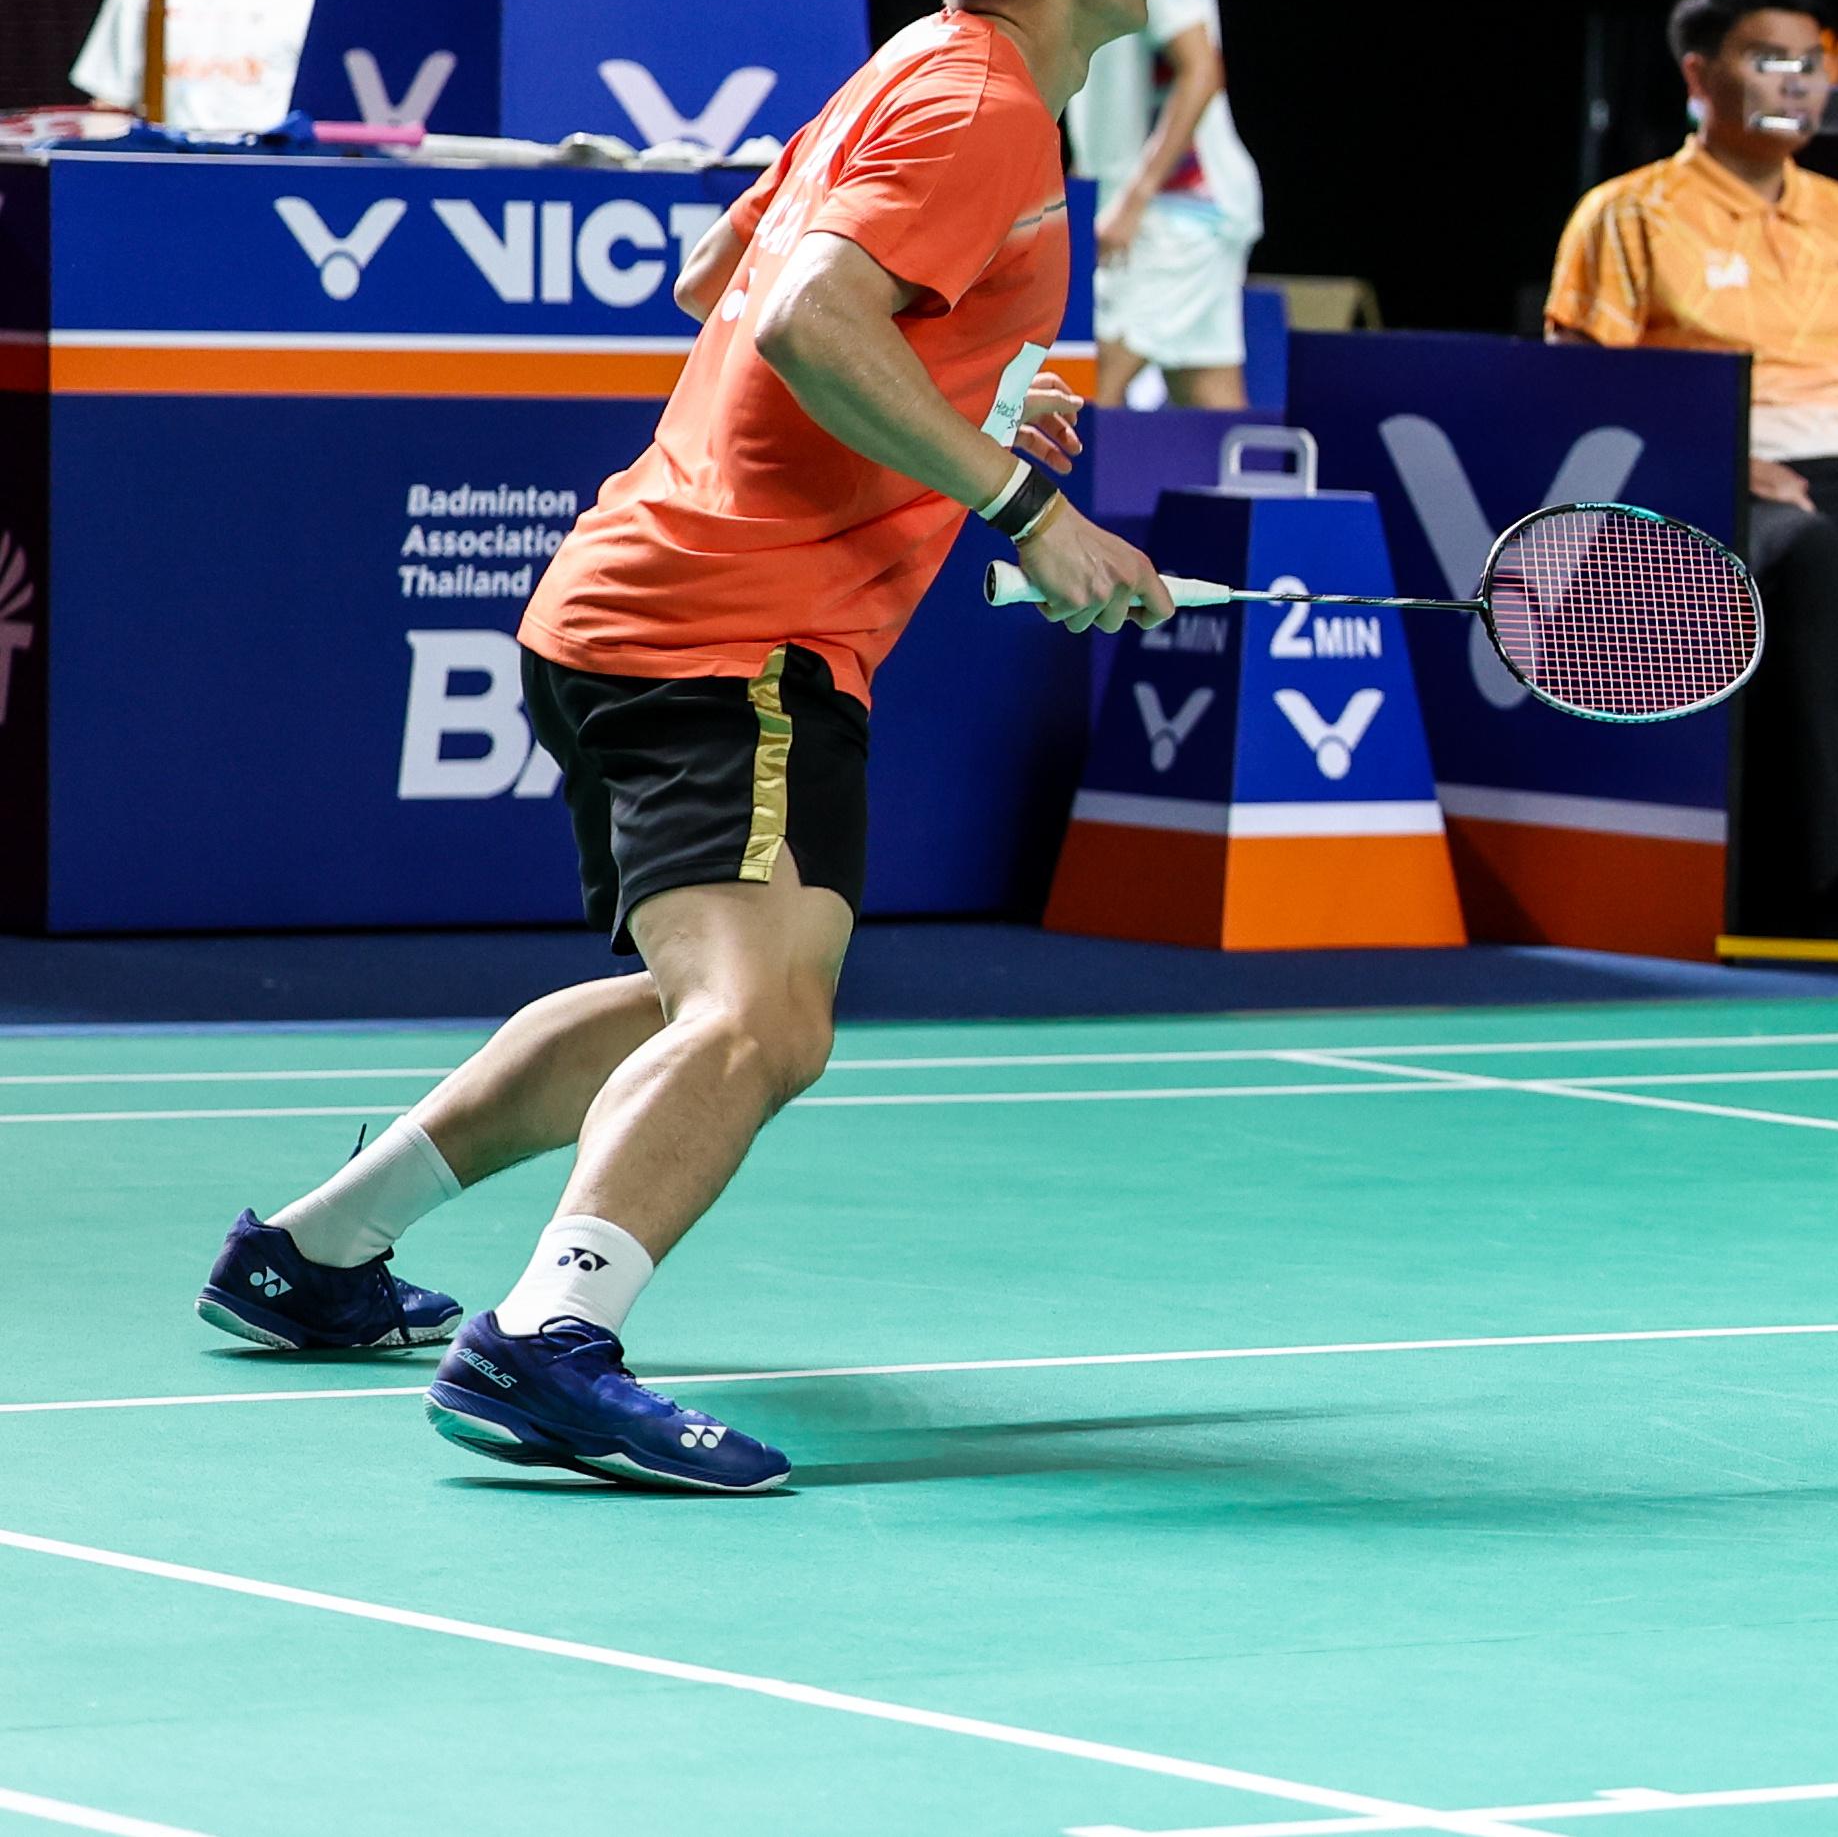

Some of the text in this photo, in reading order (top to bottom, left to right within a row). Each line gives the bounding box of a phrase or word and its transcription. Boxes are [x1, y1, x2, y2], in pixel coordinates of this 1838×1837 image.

[407, 483, 577, 516] Badminton
[401, 524, 568, 557] Associatio
[399, 564, 532, 598] Thailand
[1269, 574, 1382, 659] 2 MIN
[454, 1348, 518, 1389] AERUS
